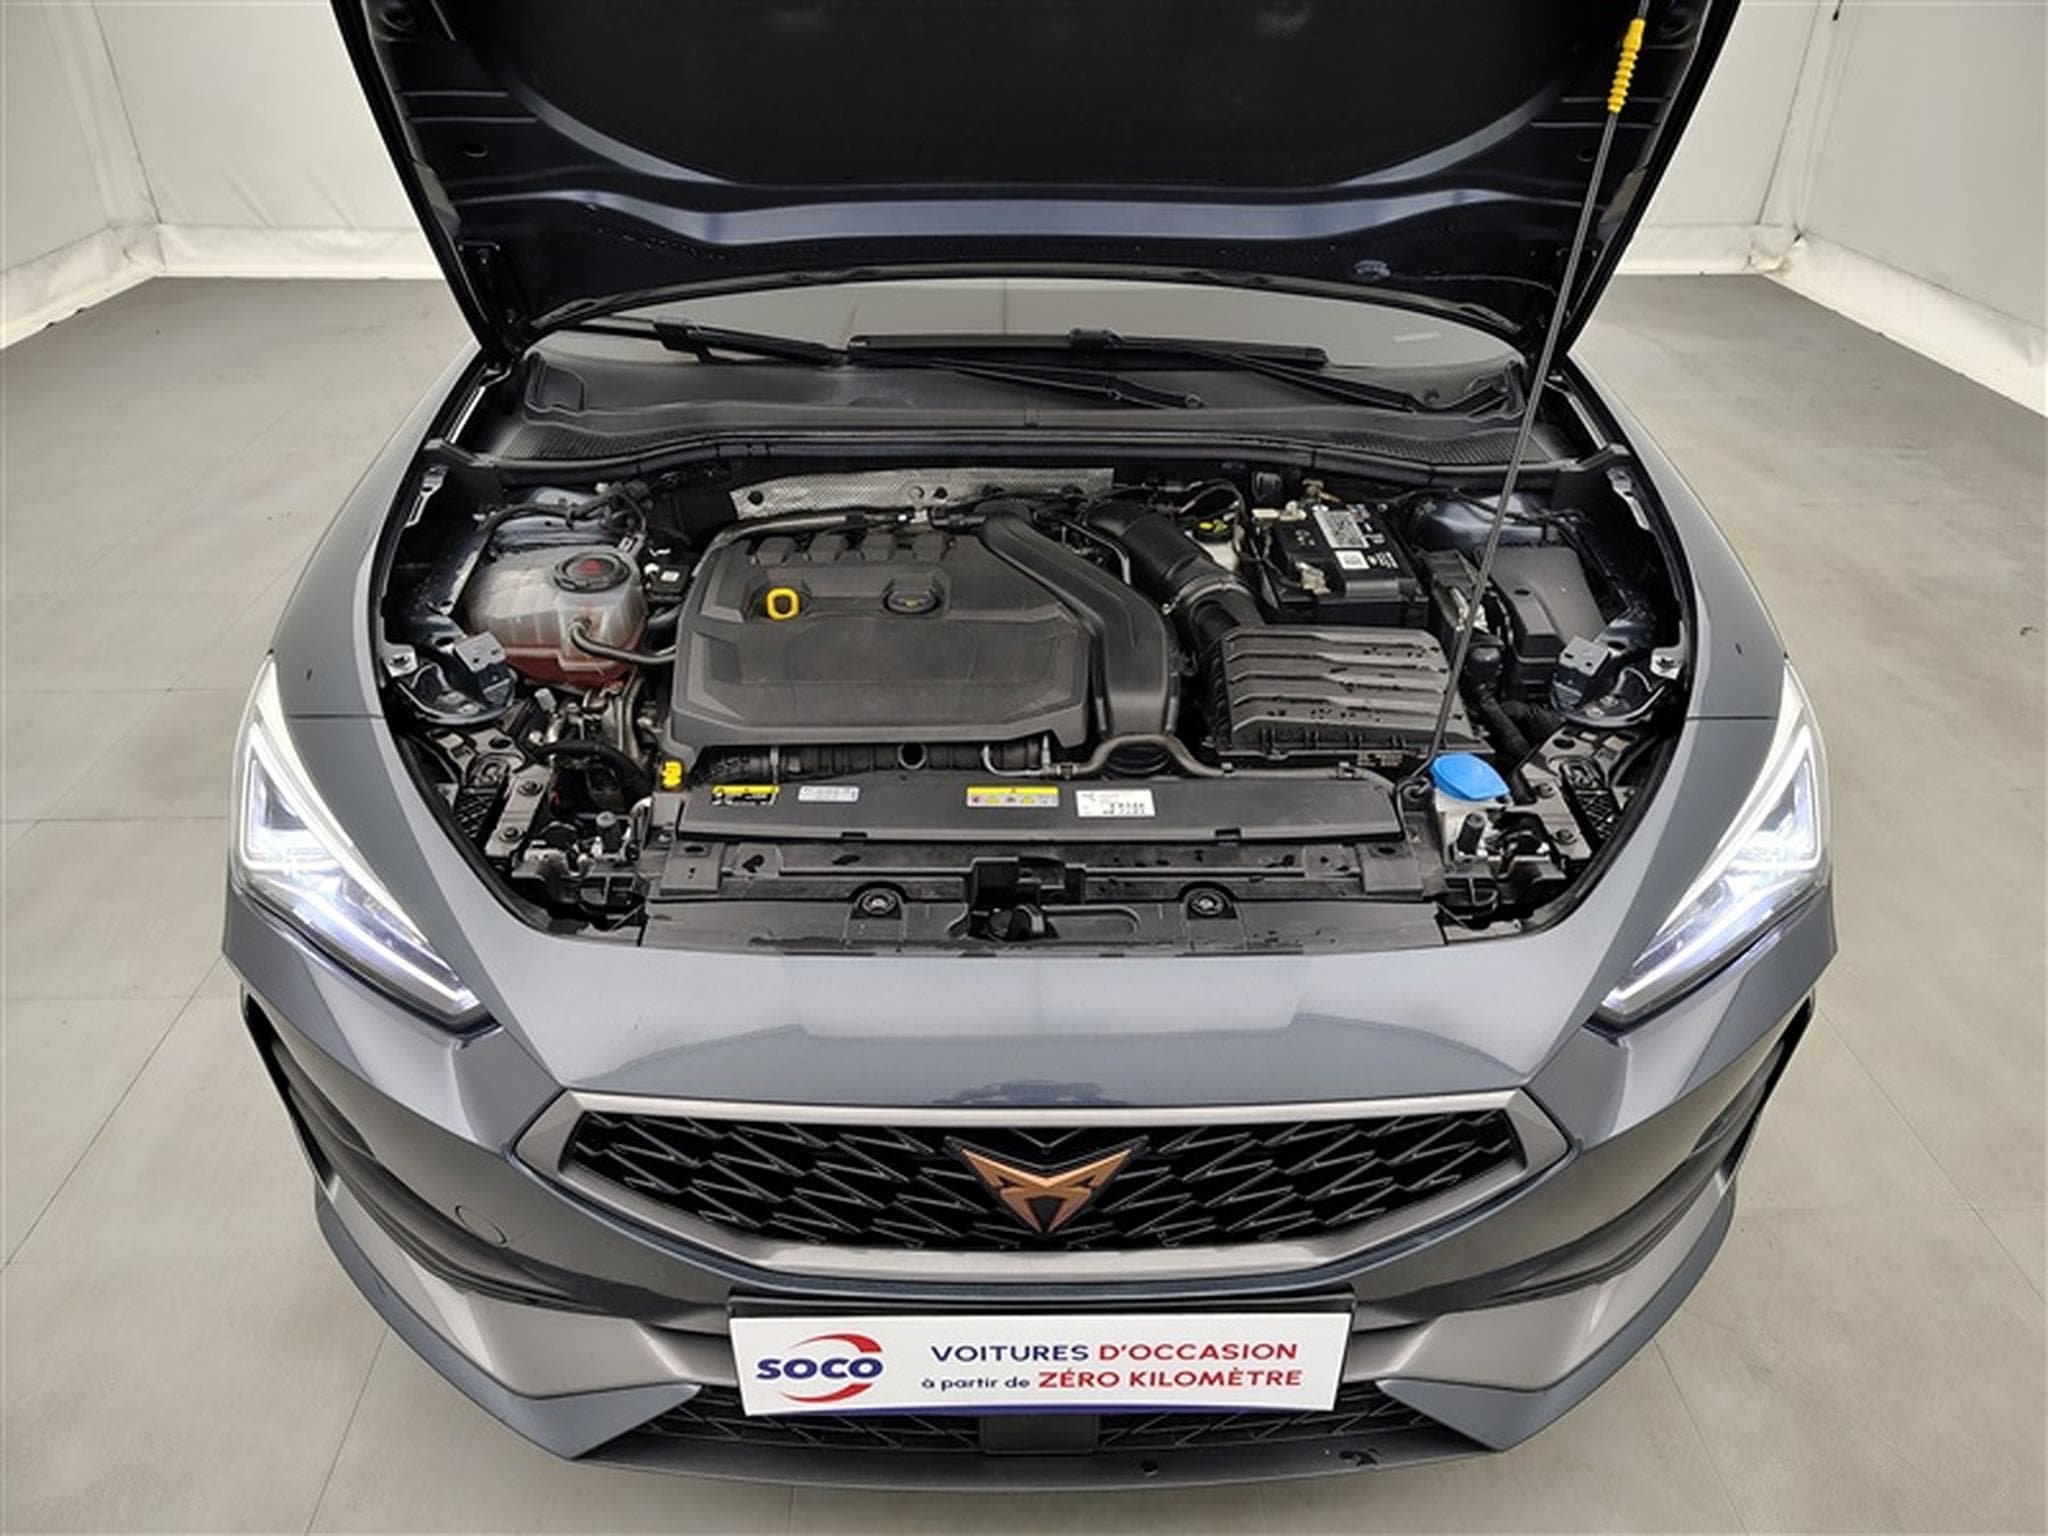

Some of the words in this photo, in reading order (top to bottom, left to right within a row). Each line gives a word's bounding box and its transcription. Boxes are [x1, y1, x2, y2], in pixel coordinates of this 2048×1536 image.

[930, 1344, 1089, 1363] VOITURES
[1099, 1343, 1299, 1362] D'OCCASION
[755, 1356, 884, 1380] SOCO
[920, 1375, 935, 1389] à
[941, 1375, 999, 1392] partir
[1004, 1376, 1031, 1389] de
[1038, 1367, 1121, 1389] ZÉRO
[1129, 1366, 1303, 1388] KILOMÈTRE
